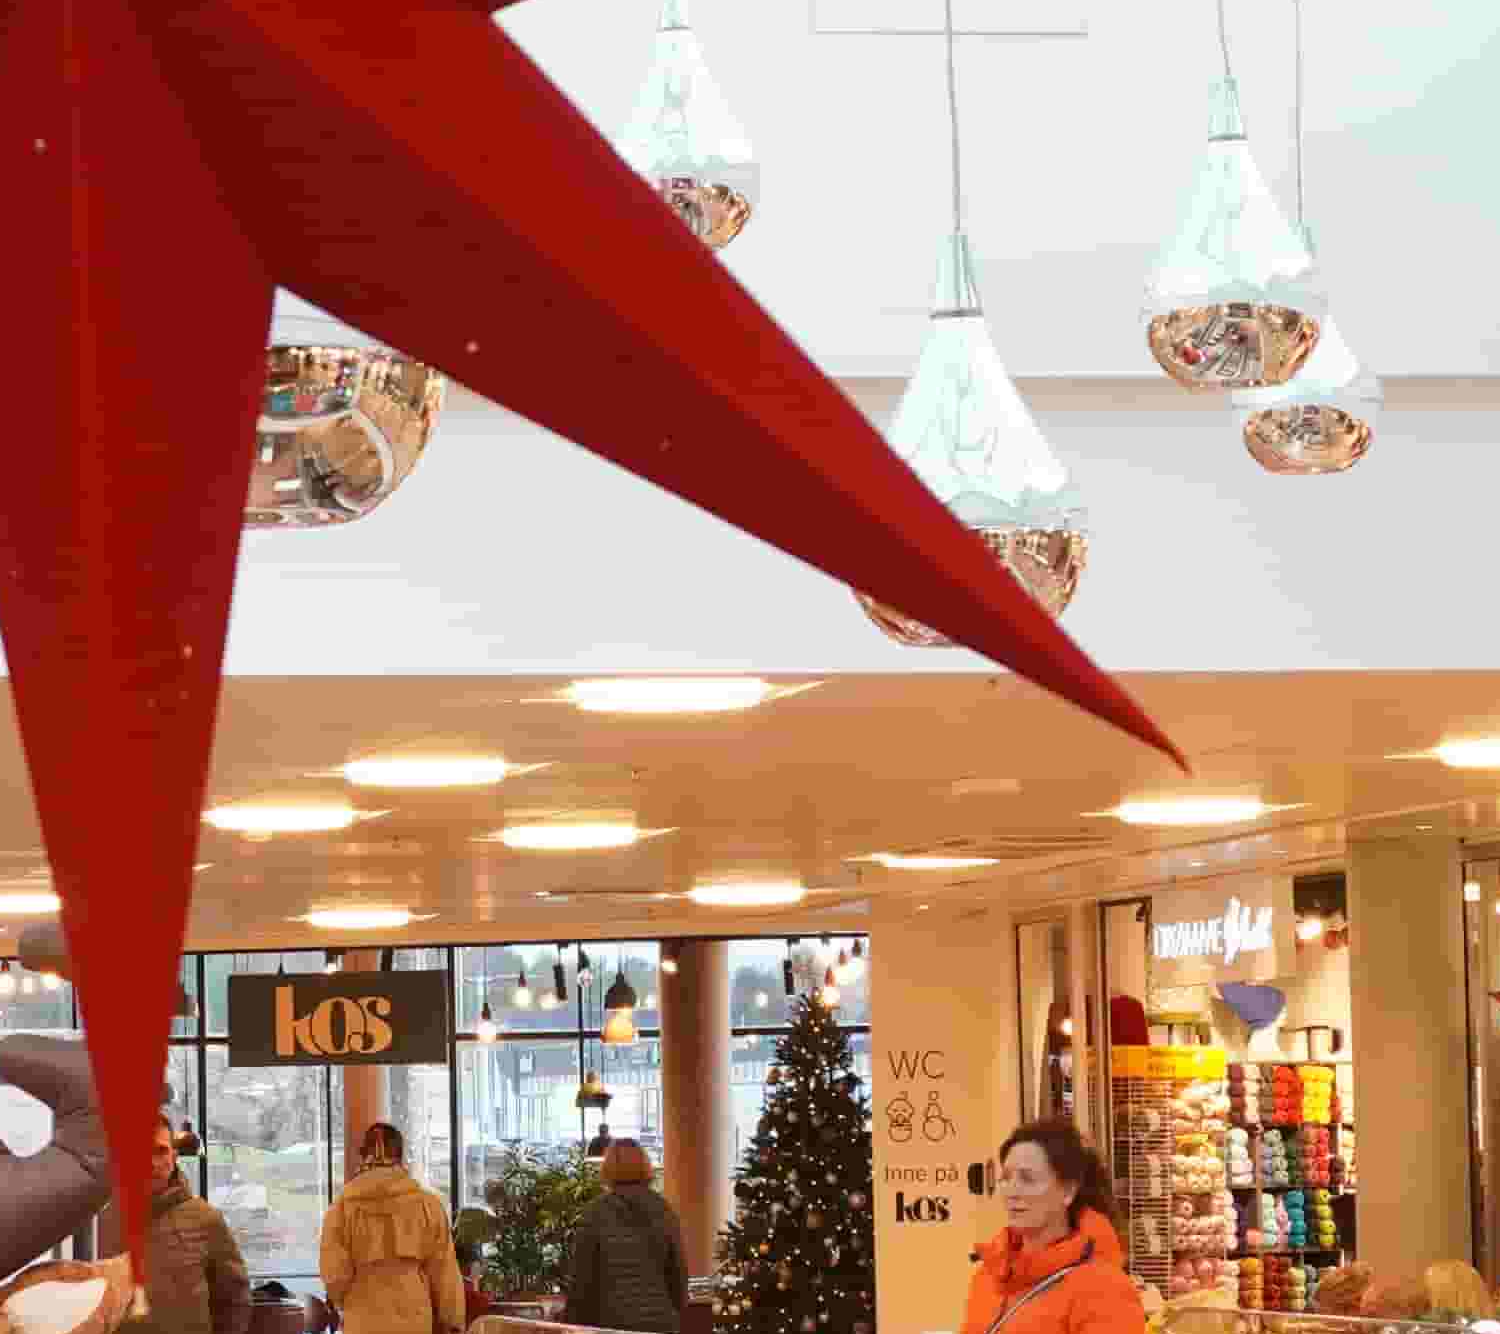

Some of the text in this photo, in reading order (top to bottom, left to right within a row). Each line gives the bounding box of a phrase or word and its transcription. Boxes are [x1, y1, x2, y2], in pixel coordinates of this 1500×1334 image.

[275, 984, 392, 1057] kos
[888, 1050, 945, 1081] WC
[895, 1191, 951, 1223] kos
